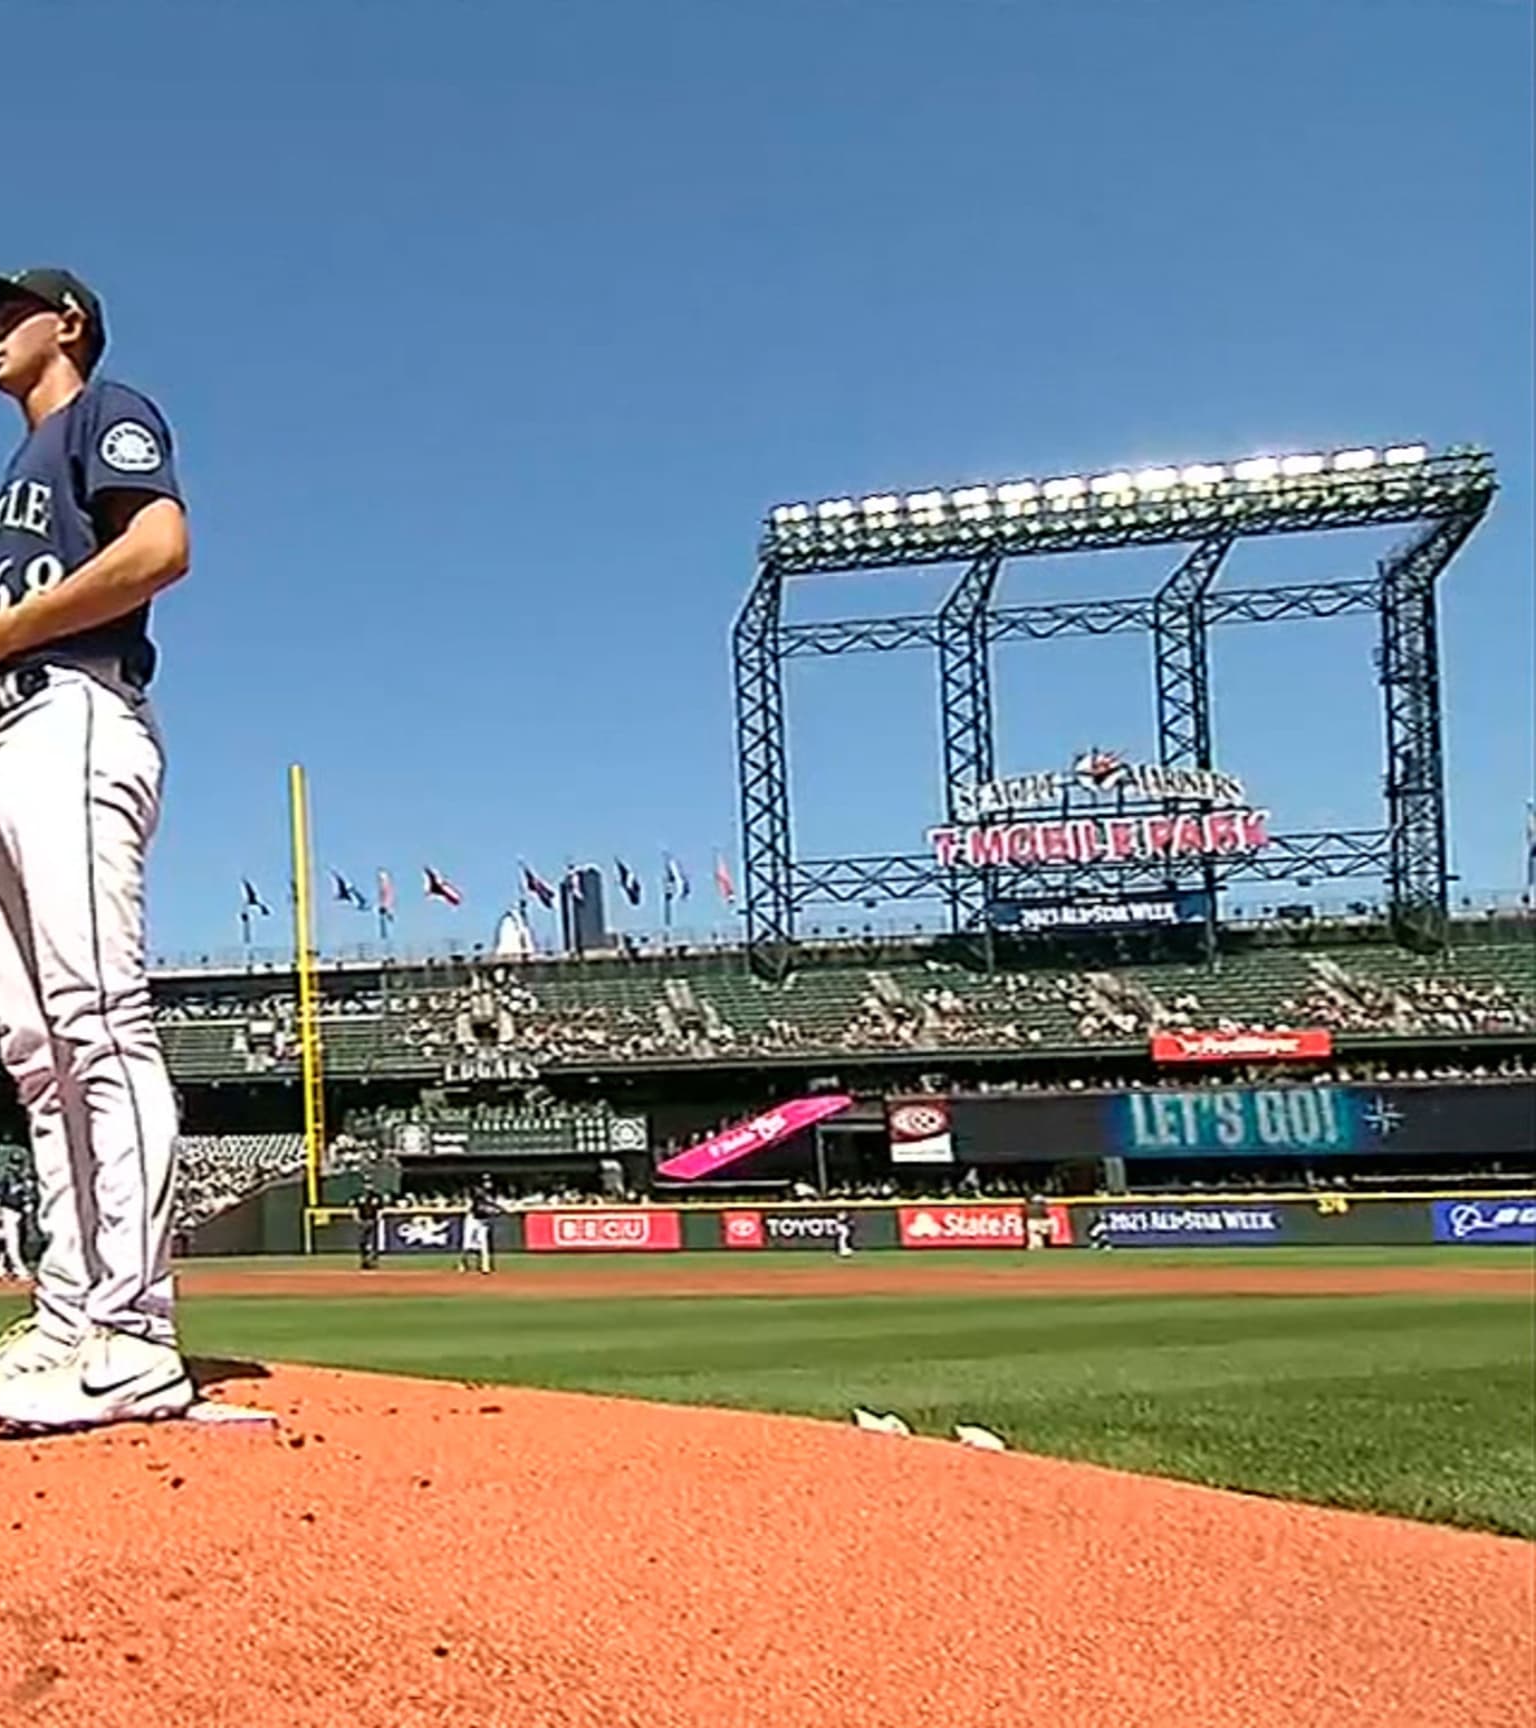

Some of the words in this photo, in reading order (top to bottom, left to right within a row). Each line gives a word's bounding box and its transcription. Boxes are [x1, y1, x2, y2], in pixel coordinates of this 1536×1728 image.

[1144, 810, 1270, 857] PARK
[1129, 1091, 1244, 1145] LET'S
[1254, 1088, 1338, 1145] GO!
[563, 1220, 642, 1239] BECU
[766, 1218, 841, 1237] TOYOT
[1222, 1210, 1276, 1230] WEEK
